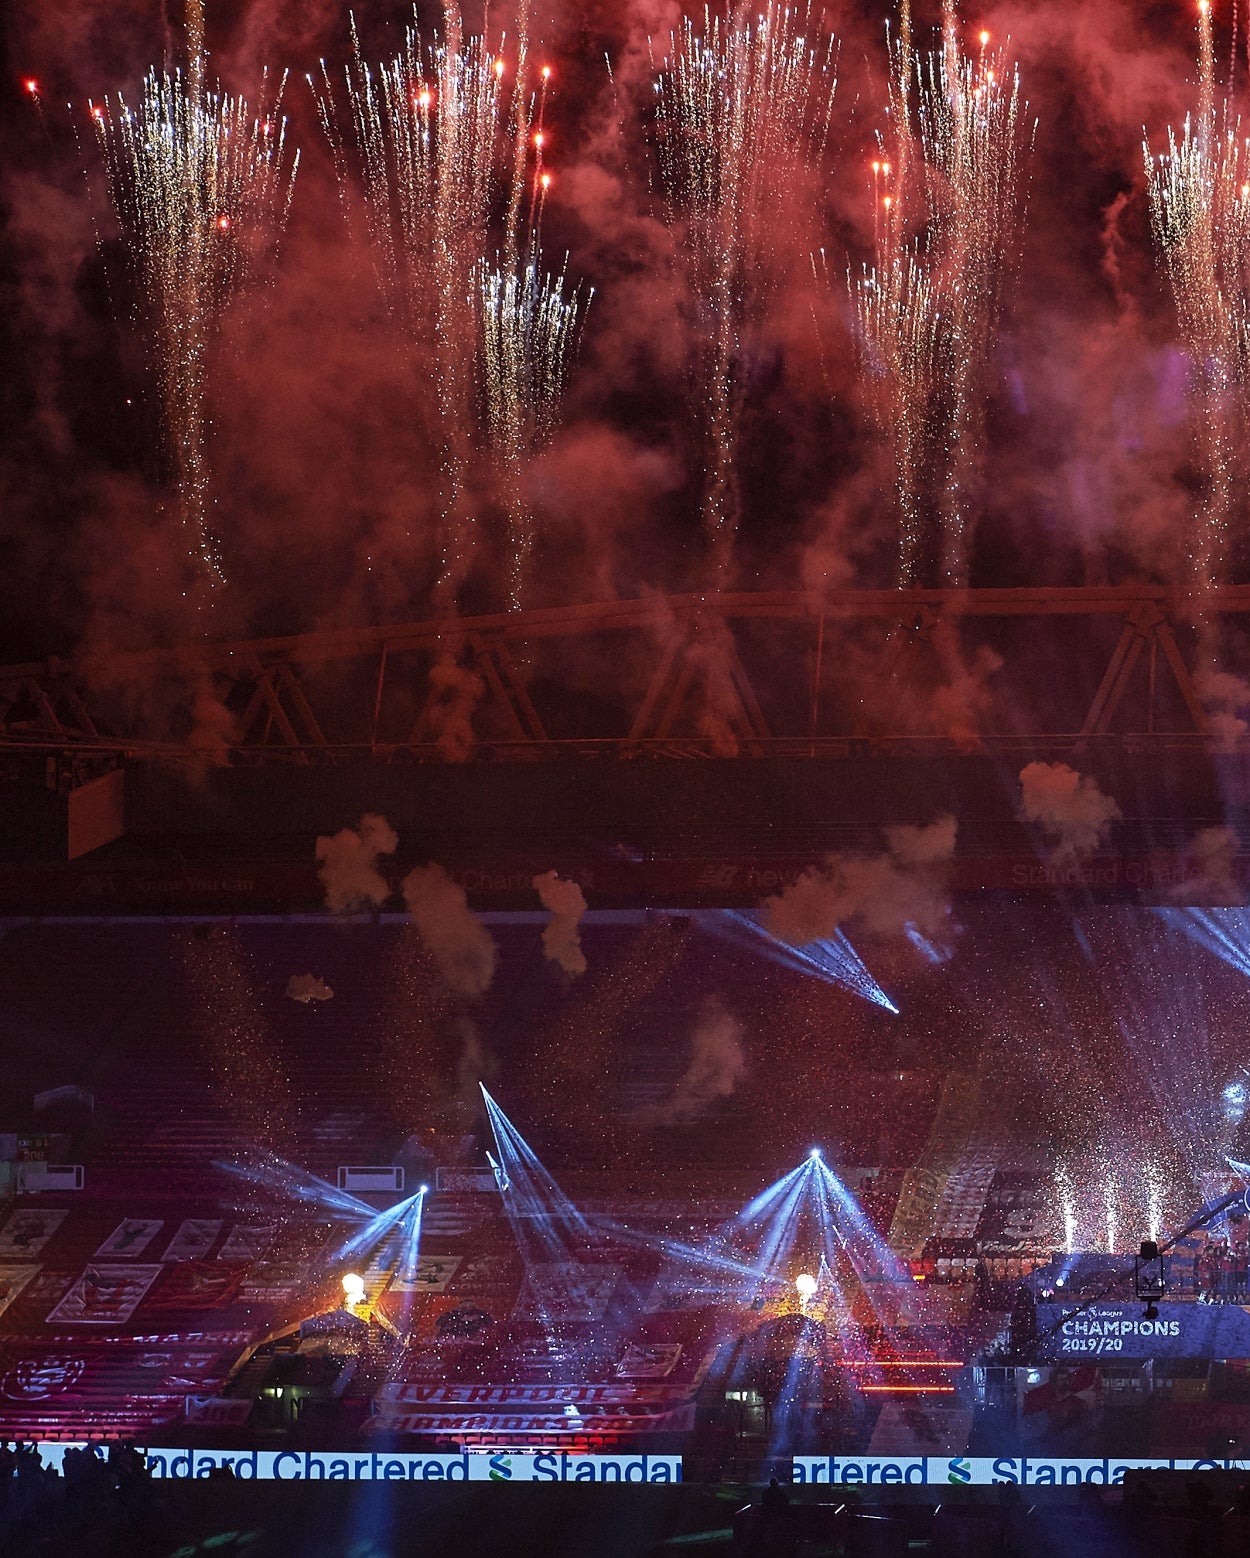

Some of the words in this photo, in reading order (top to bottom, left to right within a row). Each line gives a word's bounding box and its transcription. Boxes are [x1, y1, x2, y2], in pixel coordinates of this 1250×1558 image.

[1097, 1309, 1123, 1318] League
[1061, 1320, 1180, 1337] CHAMPIONS
[1061, 1338, 1123, 1354] 2019/20
[273, 1451, 470, 1482] Chartered
